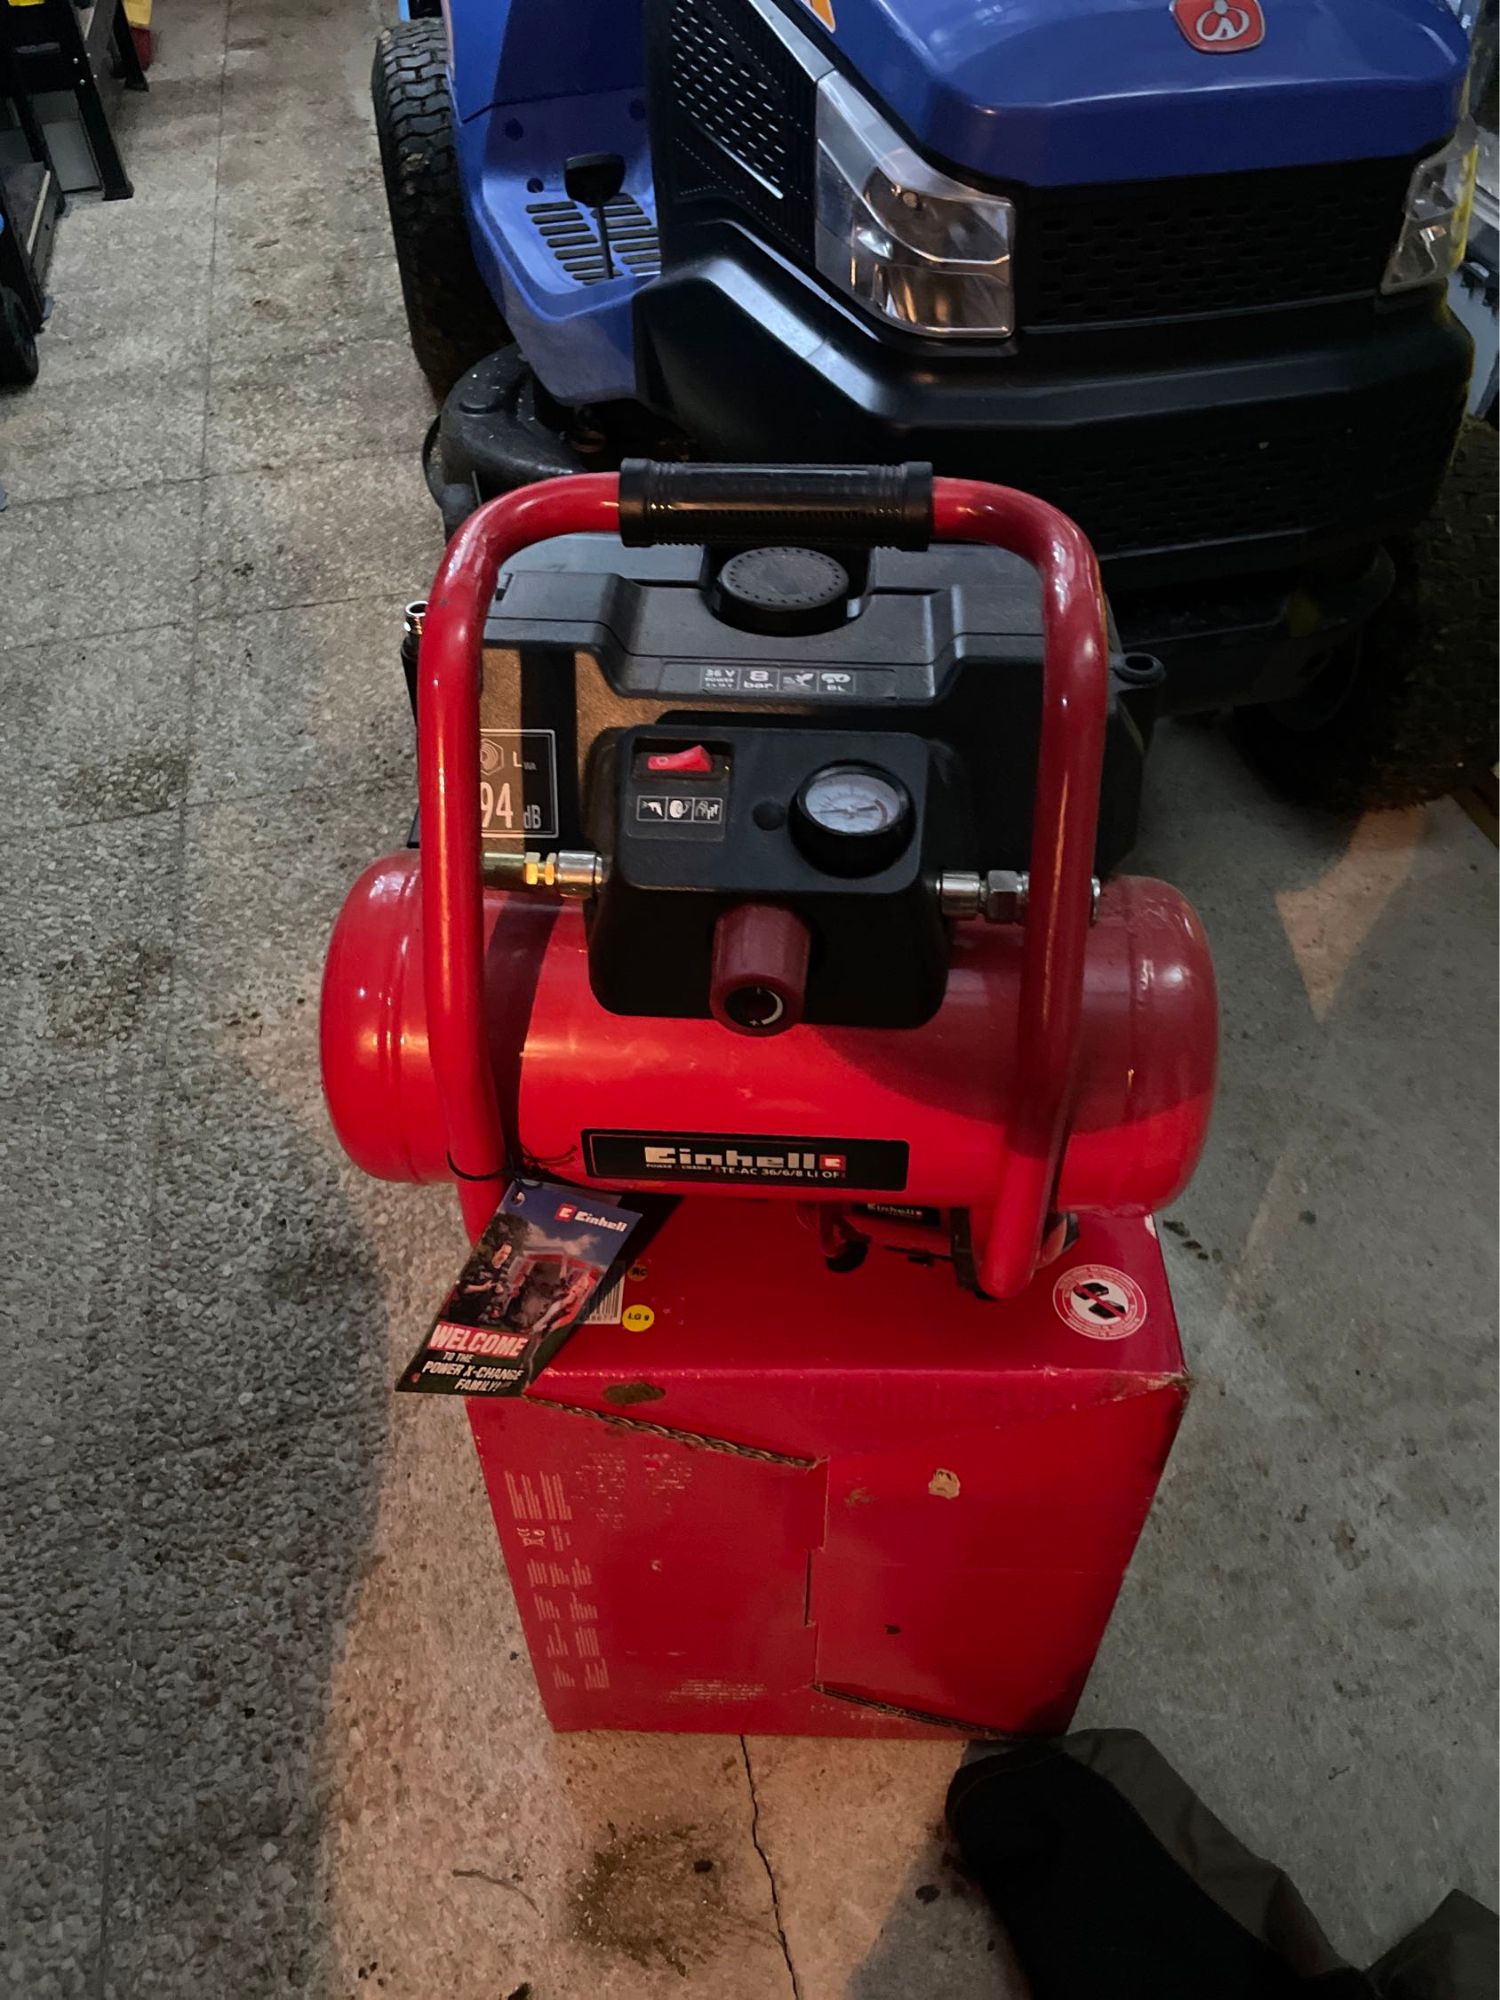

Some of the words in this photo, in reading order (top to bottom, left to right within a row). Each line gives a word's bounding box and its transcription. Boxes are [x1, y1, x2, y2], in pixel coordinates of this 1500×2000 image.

[750, 670, 768, 682] 8
[743, 680, 773, 689] bar
[480, 781, 514, 829] 94
[523, 804, 542, 829] dB
[644, 1146, 815, 1170] Einhell
[721, 1166, 758, 1176] TE-AC
[761, 1168, 803, 1178] 36/6/8
[575, 1210, 628, 1232] Einhell
[429, 1324, 528, 1356] WELCOME
[442, 1351, 456, 1361] TO
[421, 1361, 464, 1376] POWER
[462, 1365, 525, 1380] X-CHANGE
[454, 1379, 502, 1392] FAMILY!
